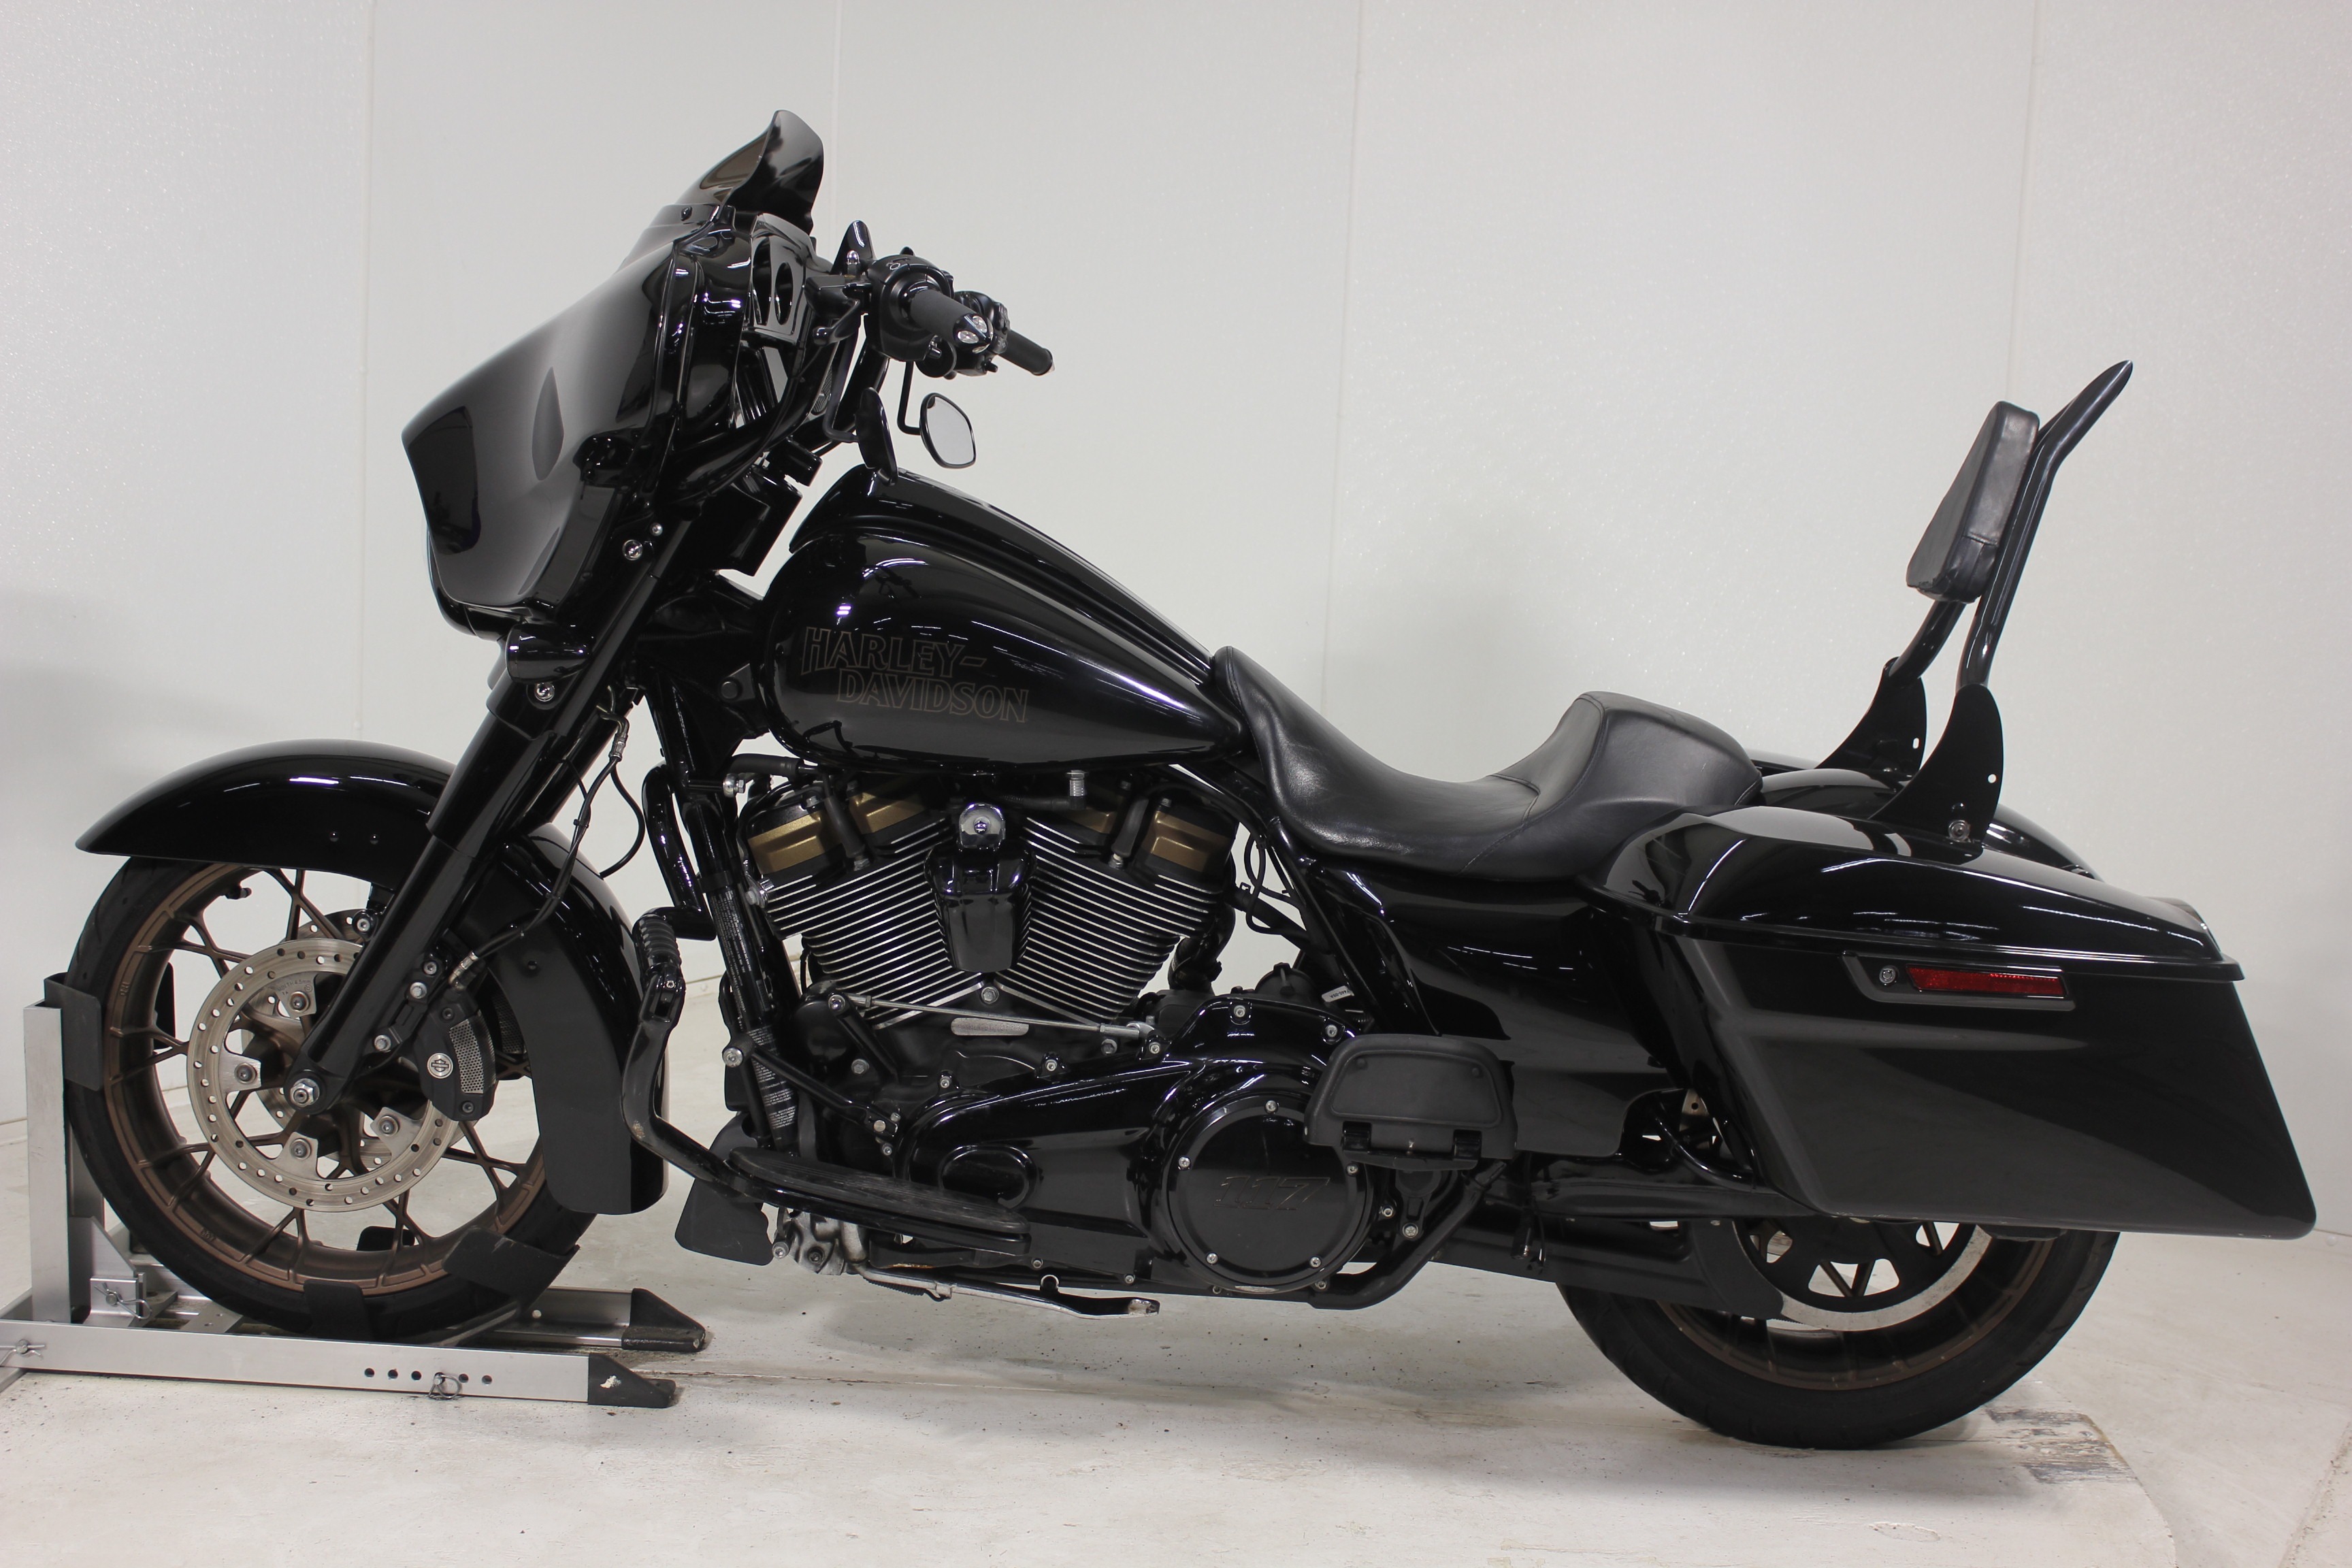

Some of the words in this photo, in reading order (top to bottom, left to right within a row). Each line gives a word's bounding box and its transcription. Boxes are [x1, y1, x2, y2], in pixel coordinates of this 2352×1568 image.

[801, 626, 986, 678] HARLEY-
[836, 669, 1029, 723] DAVIDSON
[1213, 1175, 1330, 1211] 117
